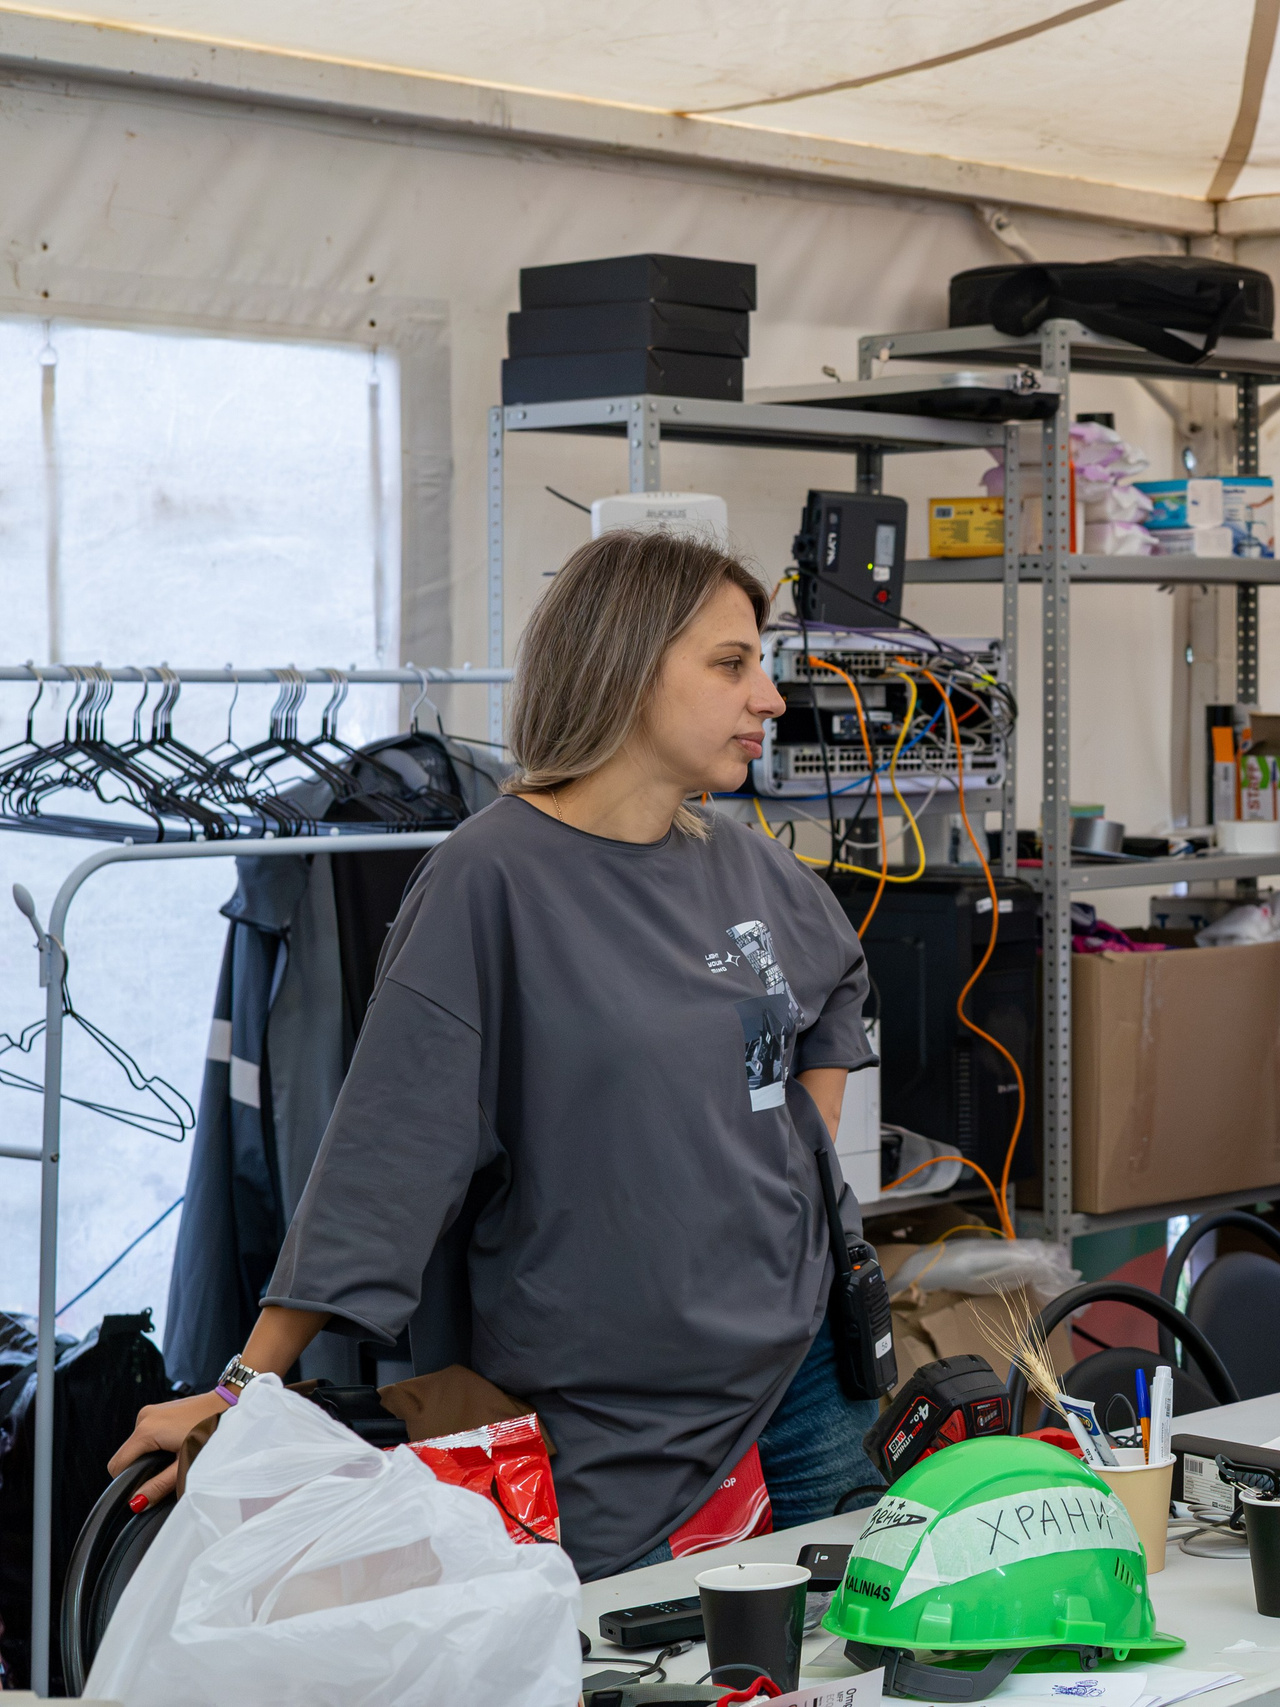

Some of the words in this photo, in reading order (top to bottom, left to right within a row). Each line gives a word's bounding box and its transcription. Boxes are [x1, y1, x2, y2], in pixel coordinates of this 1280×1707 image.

[1247, 763, 1260, 810] STAFF
[707, 960, 723, 968] YOUR
[889, 1431, 906, 1453] M18
[976, 1497, 1114, 1556] ХРАНИ
[845, 1574, 891, 1603] KALINI4S
